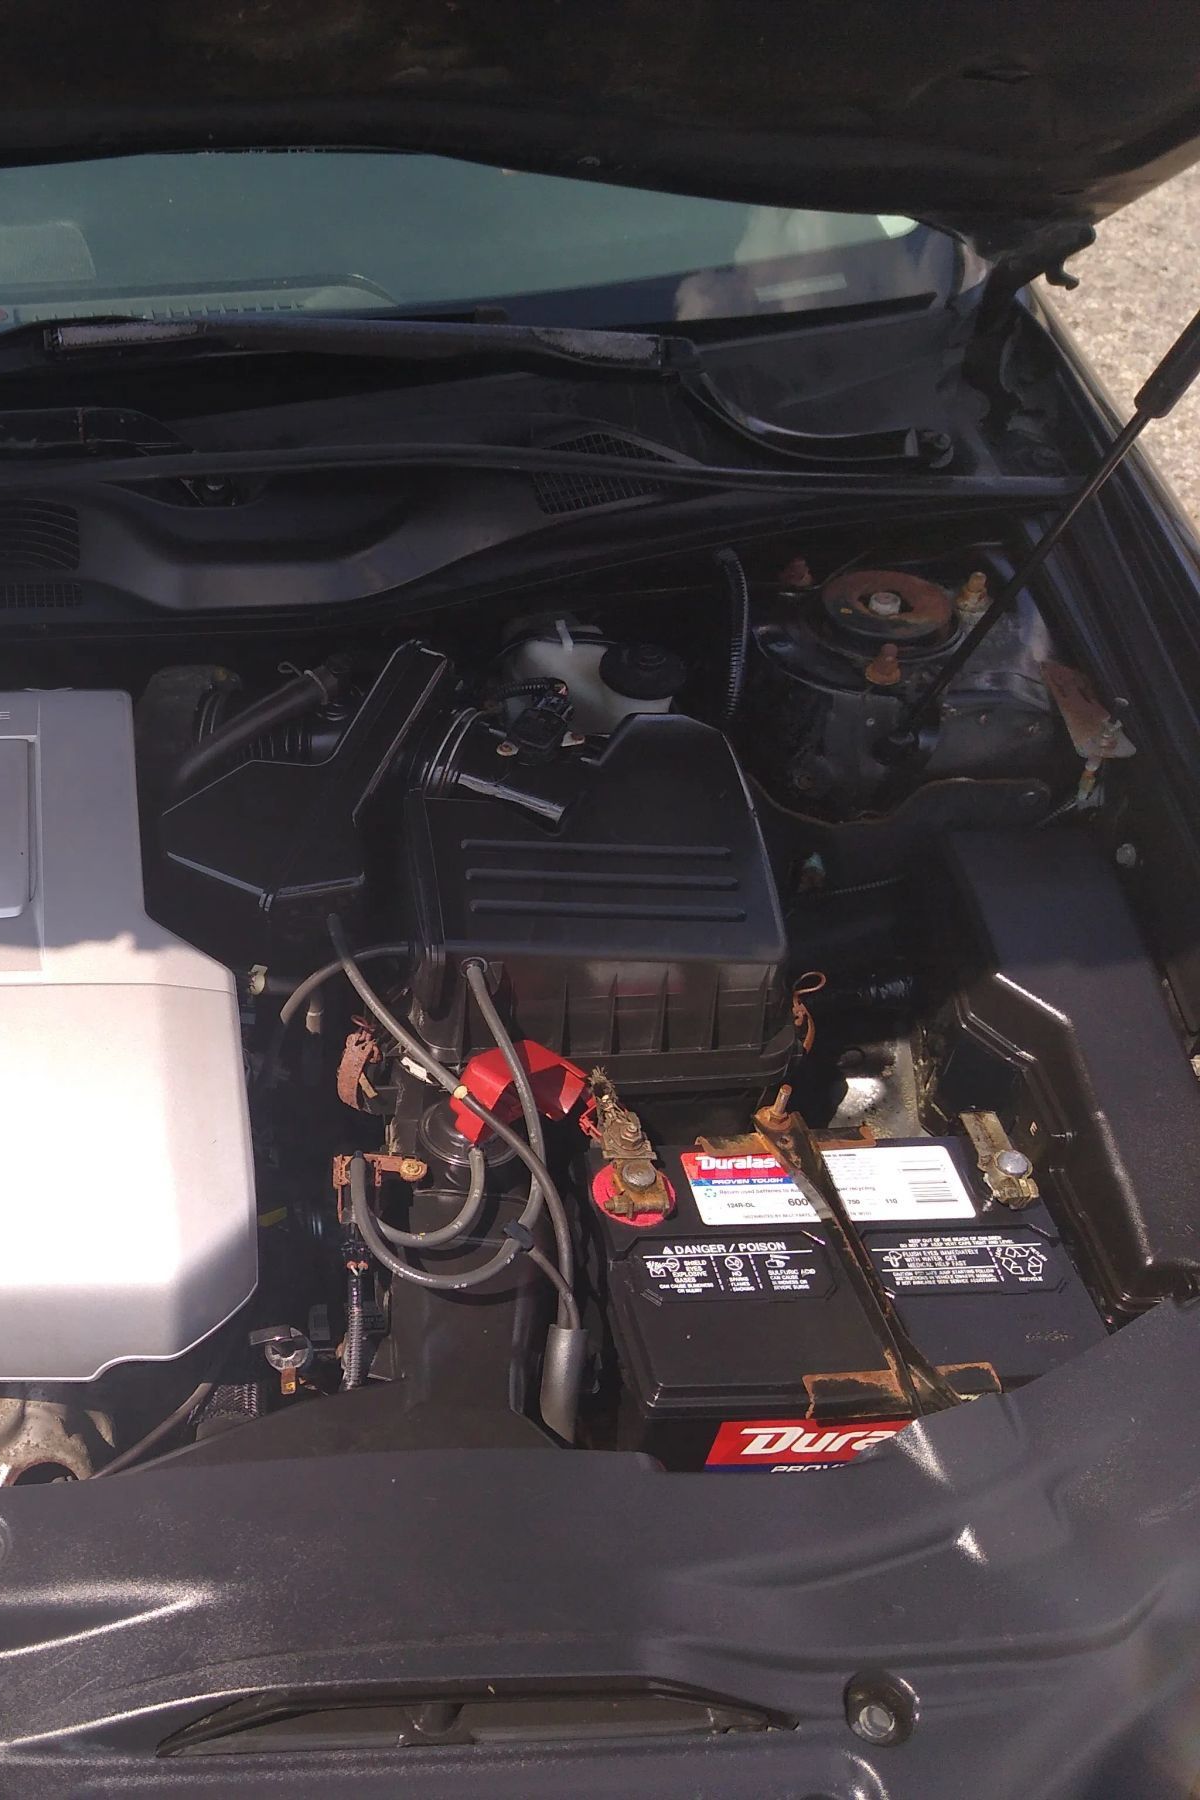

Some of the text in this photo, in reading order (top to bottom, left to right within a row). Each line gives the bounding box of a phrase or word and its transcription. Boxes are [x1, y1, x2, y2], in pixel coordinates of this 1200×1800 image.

[787, 1198, 809, 1207] 600
[674, 1244, 726, 1255] DANGER
[738, 1241, 787, 1252] POISON
[939, 1248, 979, 1256] IMMEDIATELY
